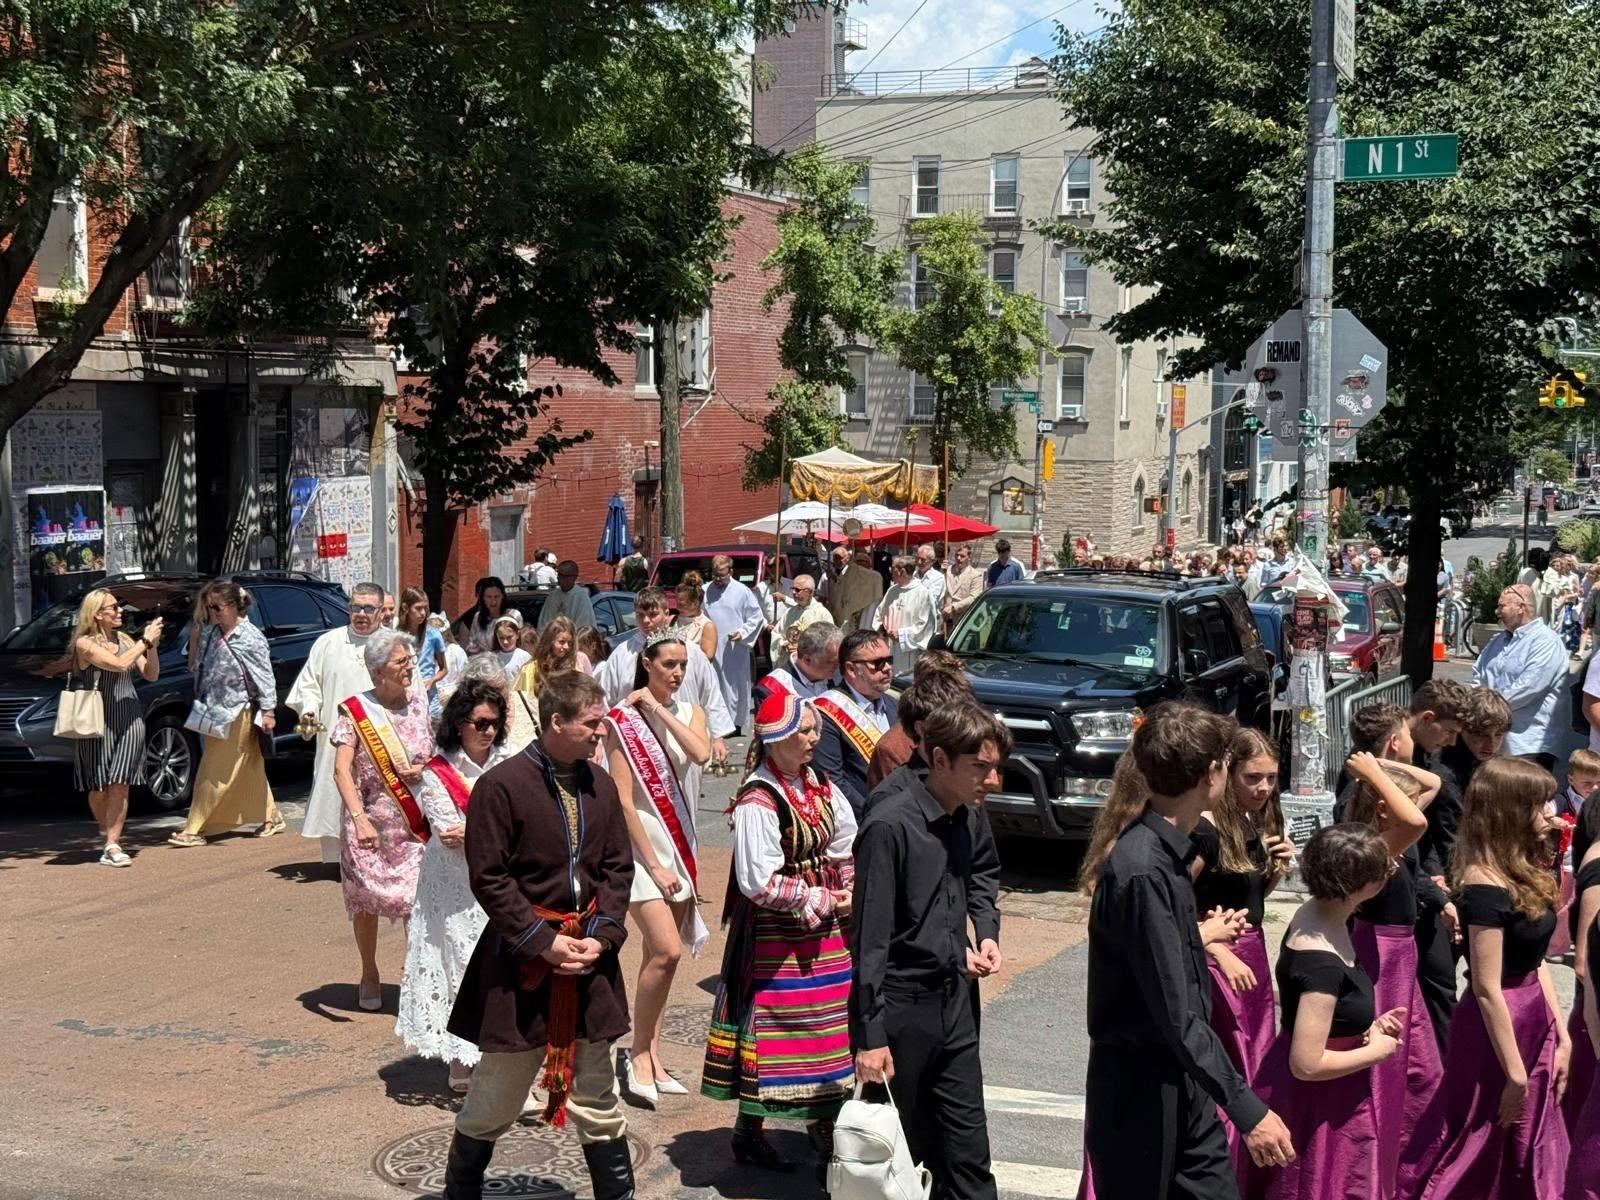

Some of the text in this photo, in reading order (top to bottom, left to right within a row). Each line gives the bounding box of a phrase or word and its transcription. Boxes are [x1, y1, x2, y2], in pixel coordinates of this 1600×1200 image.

[1368, 139, 1429, 174] N 1 St
[1266, 340, 1301, 363] REMAND
[31, 532, 67, 545] baauer
[67, 529, 103, 542] baauer
[358, 719, 399, 785] WILLIAMSBURG
